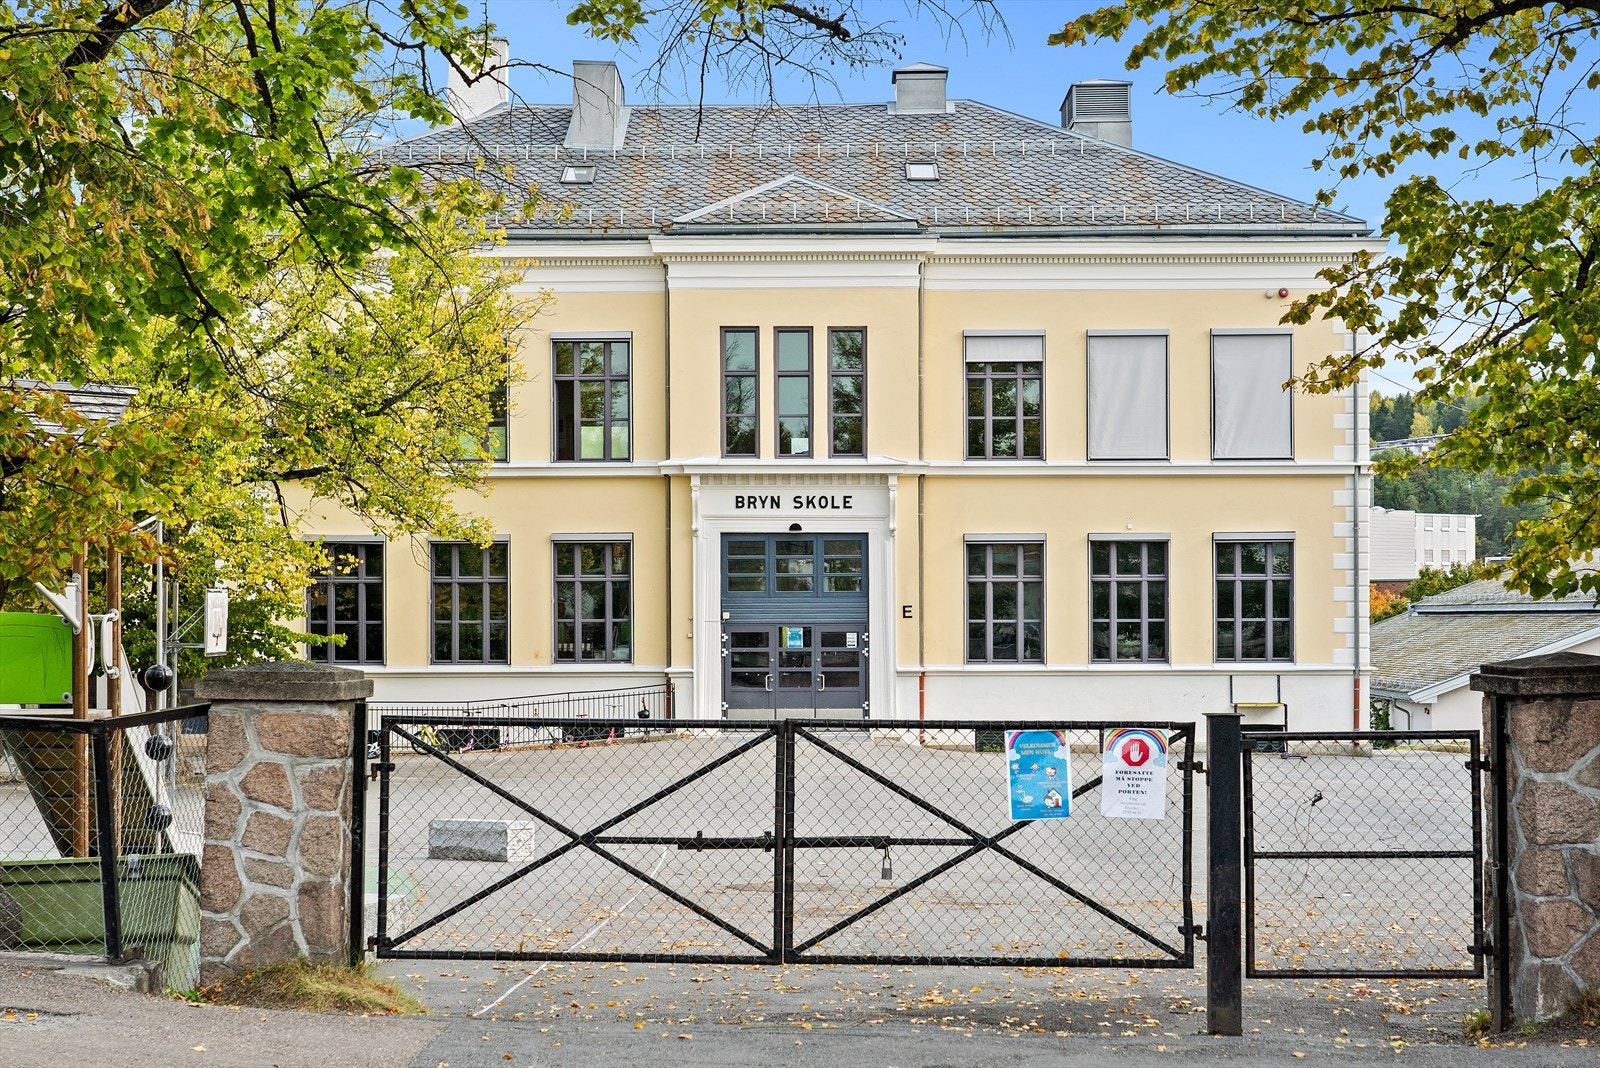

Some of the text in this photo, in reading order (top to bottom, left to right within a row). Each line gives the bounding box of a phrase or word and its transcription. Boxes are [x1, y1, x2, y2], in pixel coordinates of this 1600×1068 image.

[735, 495, 853, 509] BRYN SKOLE
[902, 605, 913, 619] E
